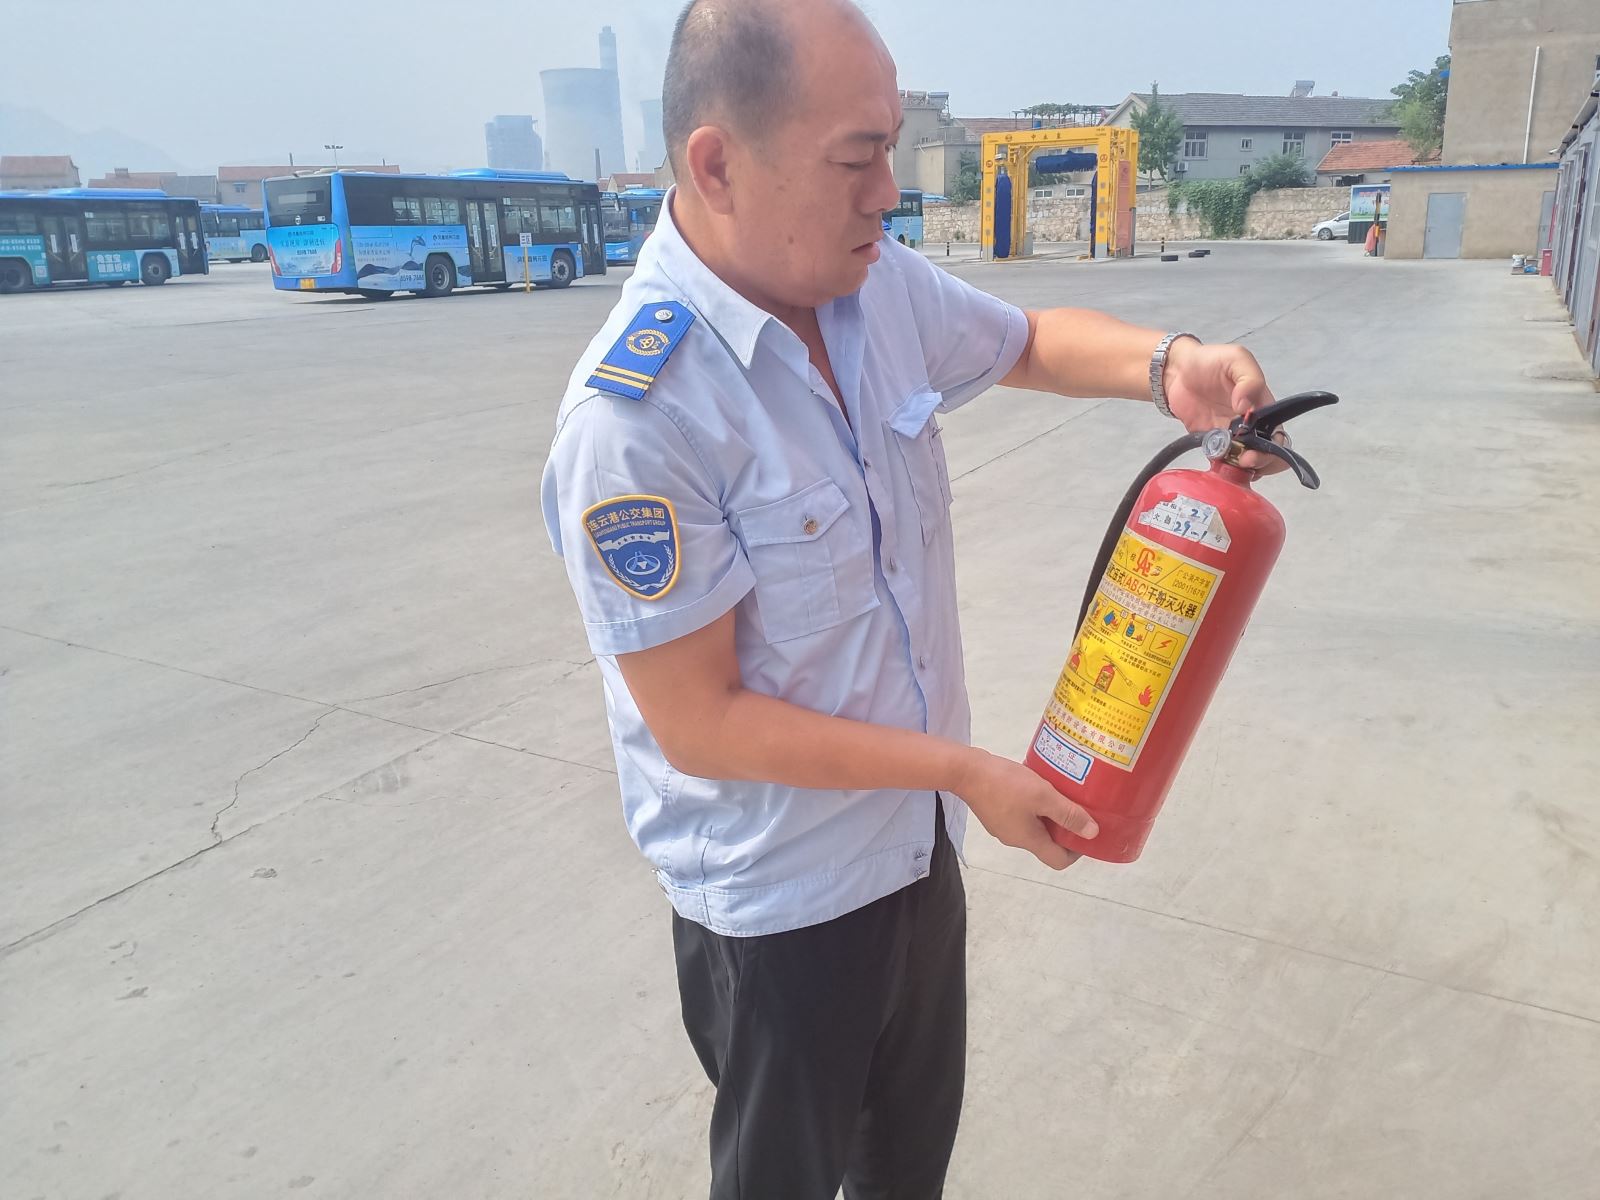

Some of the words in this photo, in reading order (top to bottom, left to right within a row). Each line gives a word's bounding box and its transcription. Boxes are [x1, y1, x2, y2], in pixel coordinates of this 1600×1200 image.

[587, 507, 665, 532] 连云港公交集团
